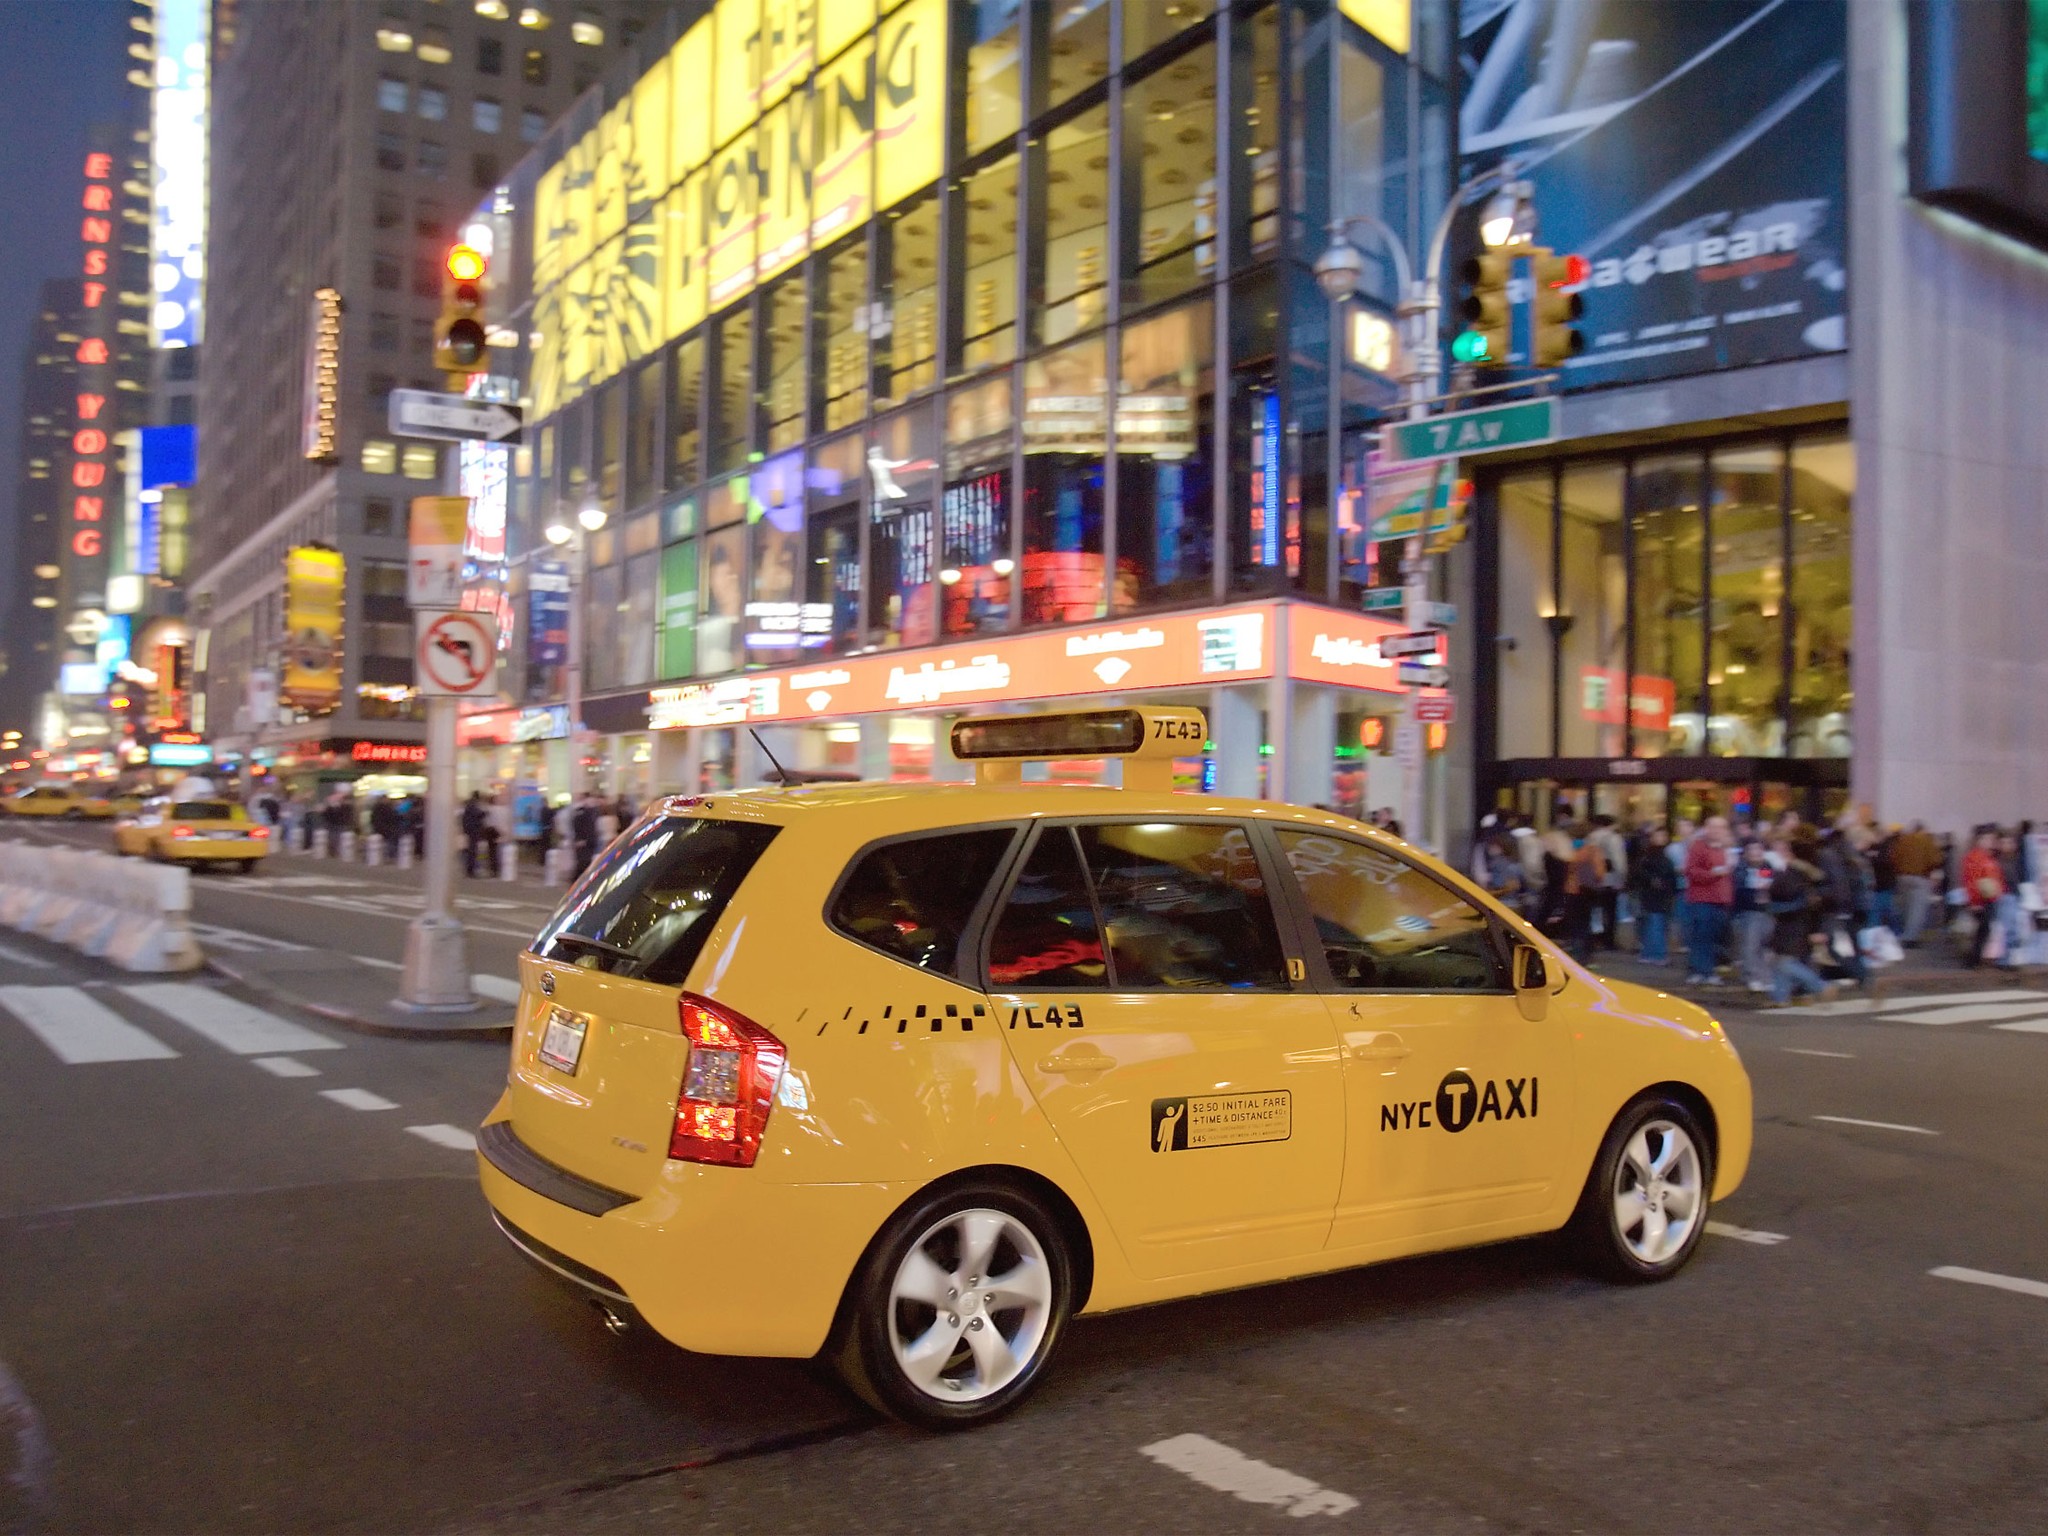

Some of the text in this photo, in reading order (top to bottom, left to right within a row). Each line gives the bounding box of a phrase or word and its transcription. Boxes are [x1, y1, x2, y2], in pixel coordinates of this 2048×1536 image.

[81, 152, 113, 308] ERNST
[1429, 420, 1503, 450] 7 Av
[72, 393, 108, 556] YOUNG
[1153, 720, 1201, 739] 7C43
[1002, 1002, 1084, 1029] 7C43
[1222, 1100, 1259, 1110] INITIAL
[1263, 1097, 1286, 1107] FARE
[1381, 1073, 1538, 1132] NYC TAXI
[1231, 1111, 1273, 1122] DISTANCE
[1192, 1135, 1207, 1143] $45
